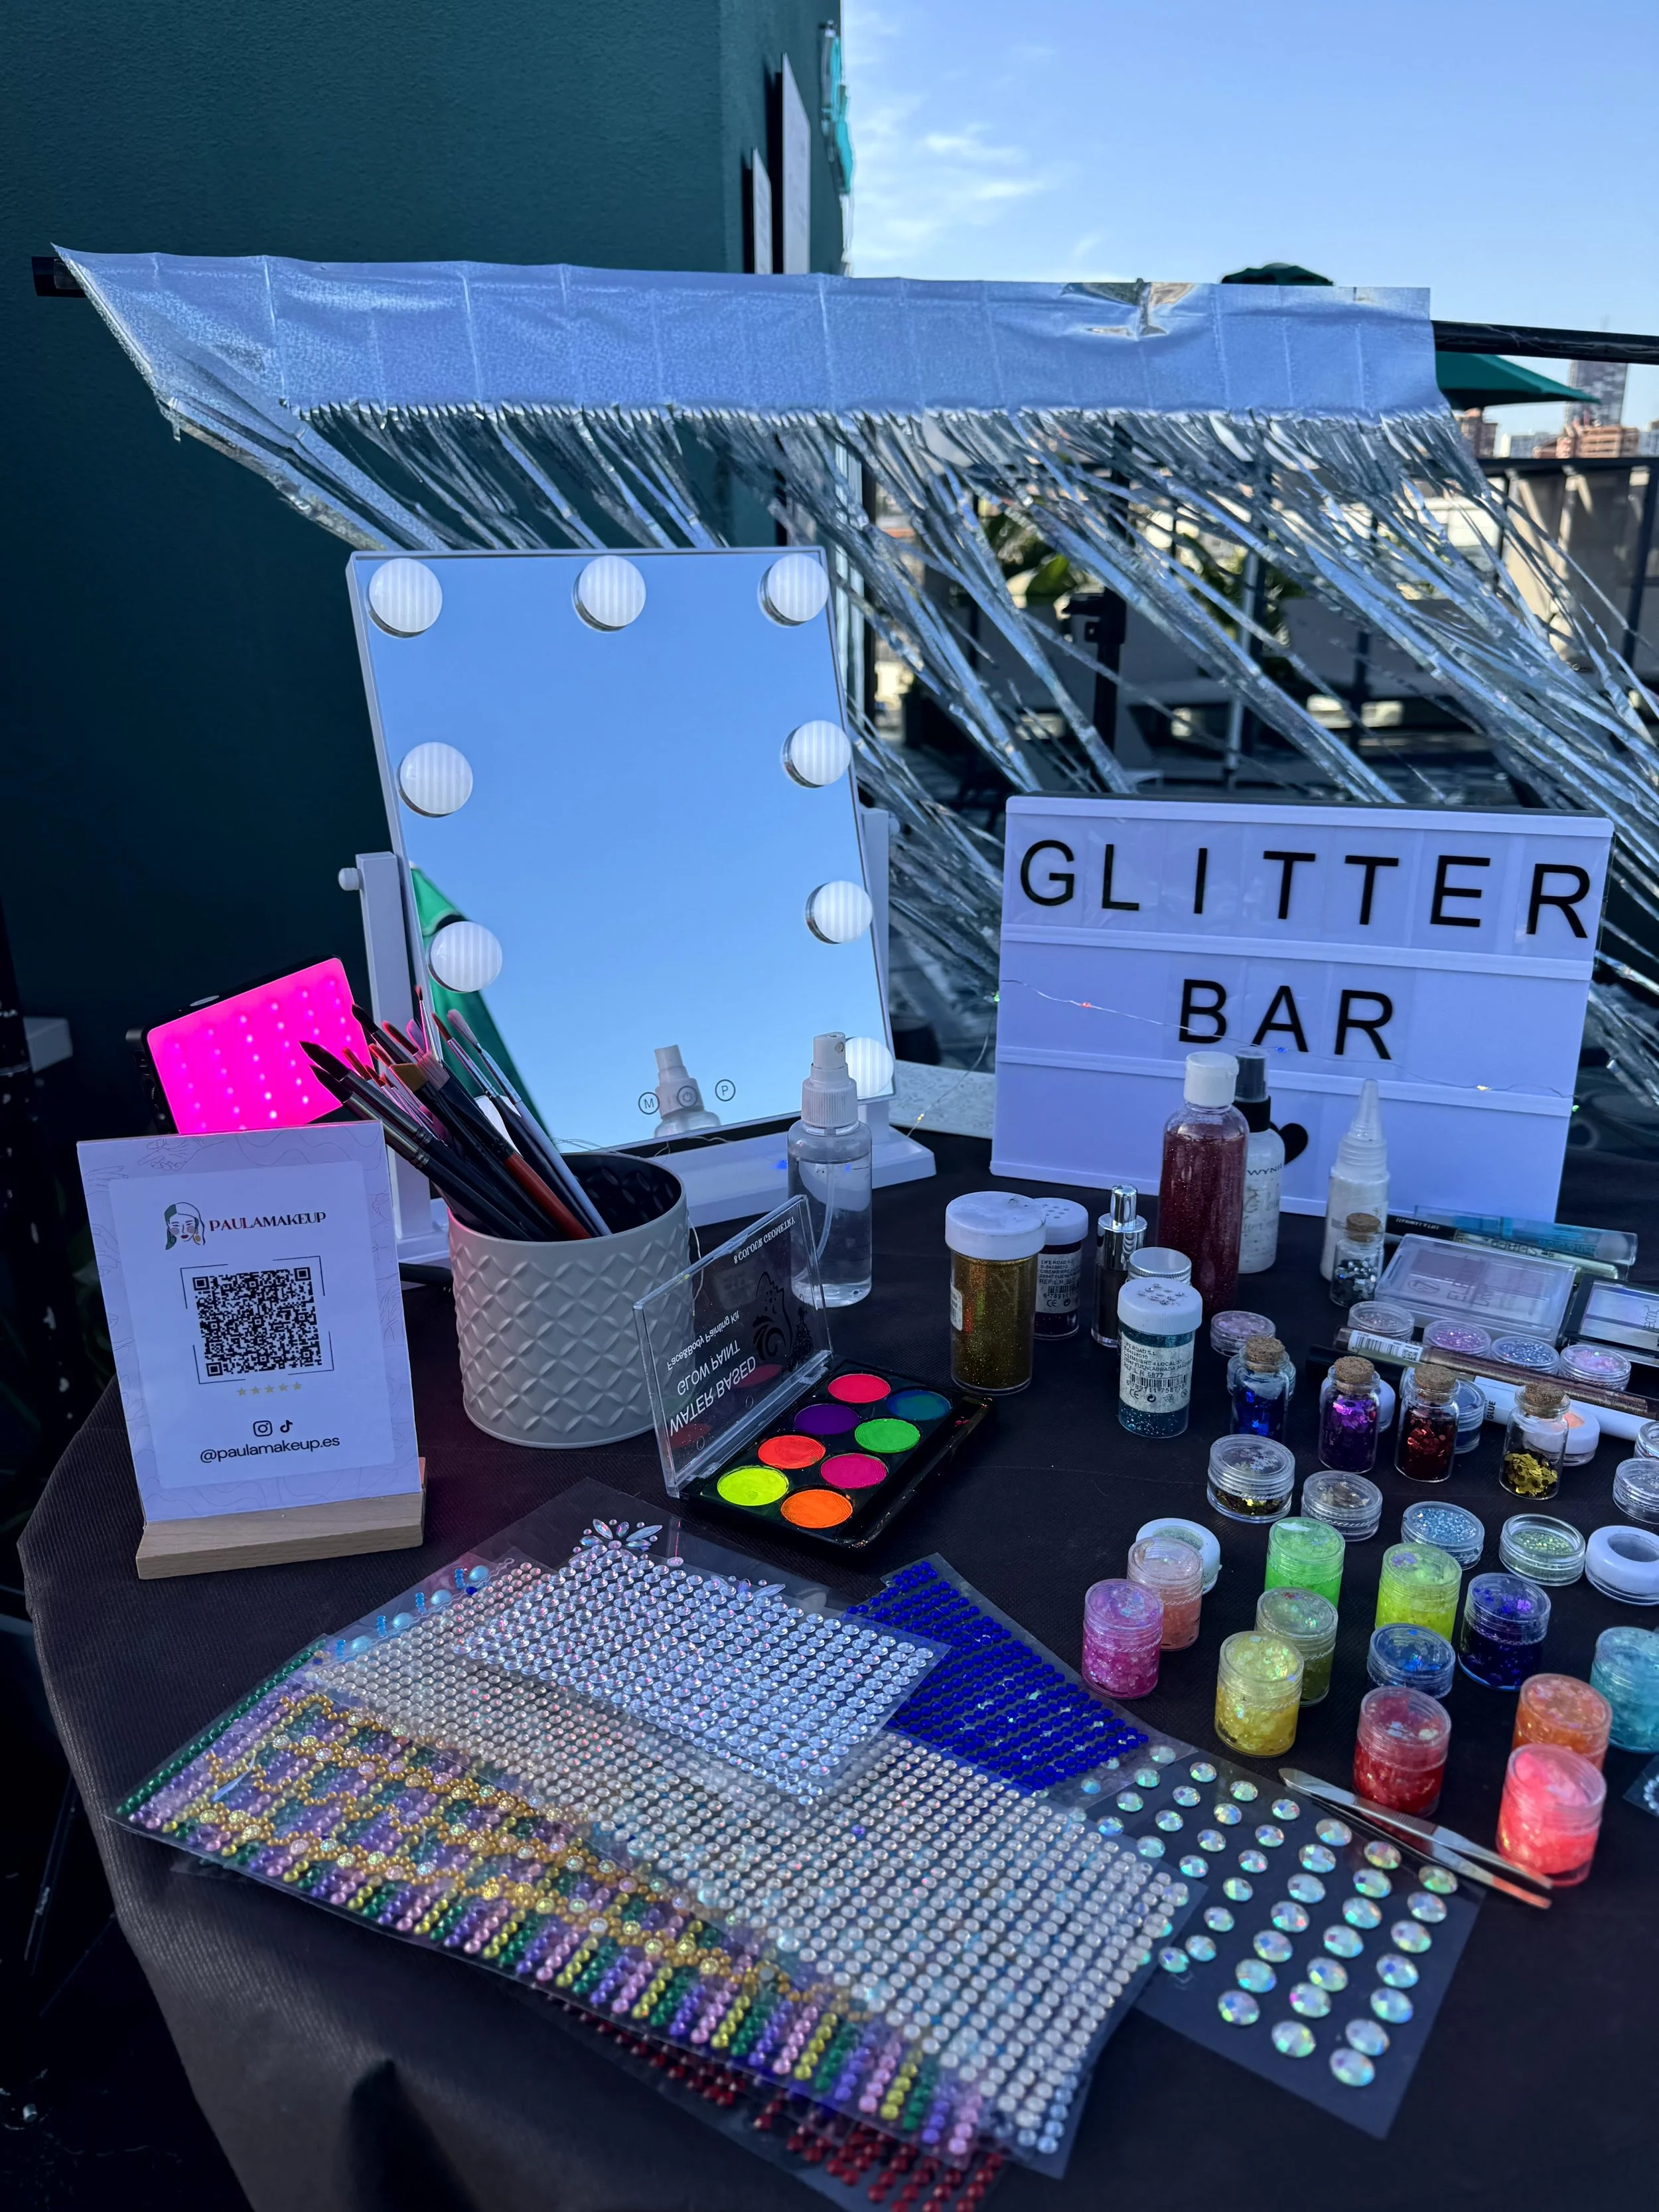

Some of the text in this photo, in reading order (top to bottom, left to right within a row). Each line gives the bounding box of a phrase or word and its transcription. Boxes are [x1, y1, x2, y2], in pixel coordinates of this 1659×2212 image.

[1019, 840, 1591, 939] GLITTER
[1179, 978, 1394, 1061] BAR
[721, 1085, 729, 1096] P
[644, 1098, 654, 1109] M
[209, 1211, 326, 1232] PAULAMAKEUP
[1486, 1400, 1496, 1420] GLUE
[200, 1437, 340, 1463] @paulamakeup.es
